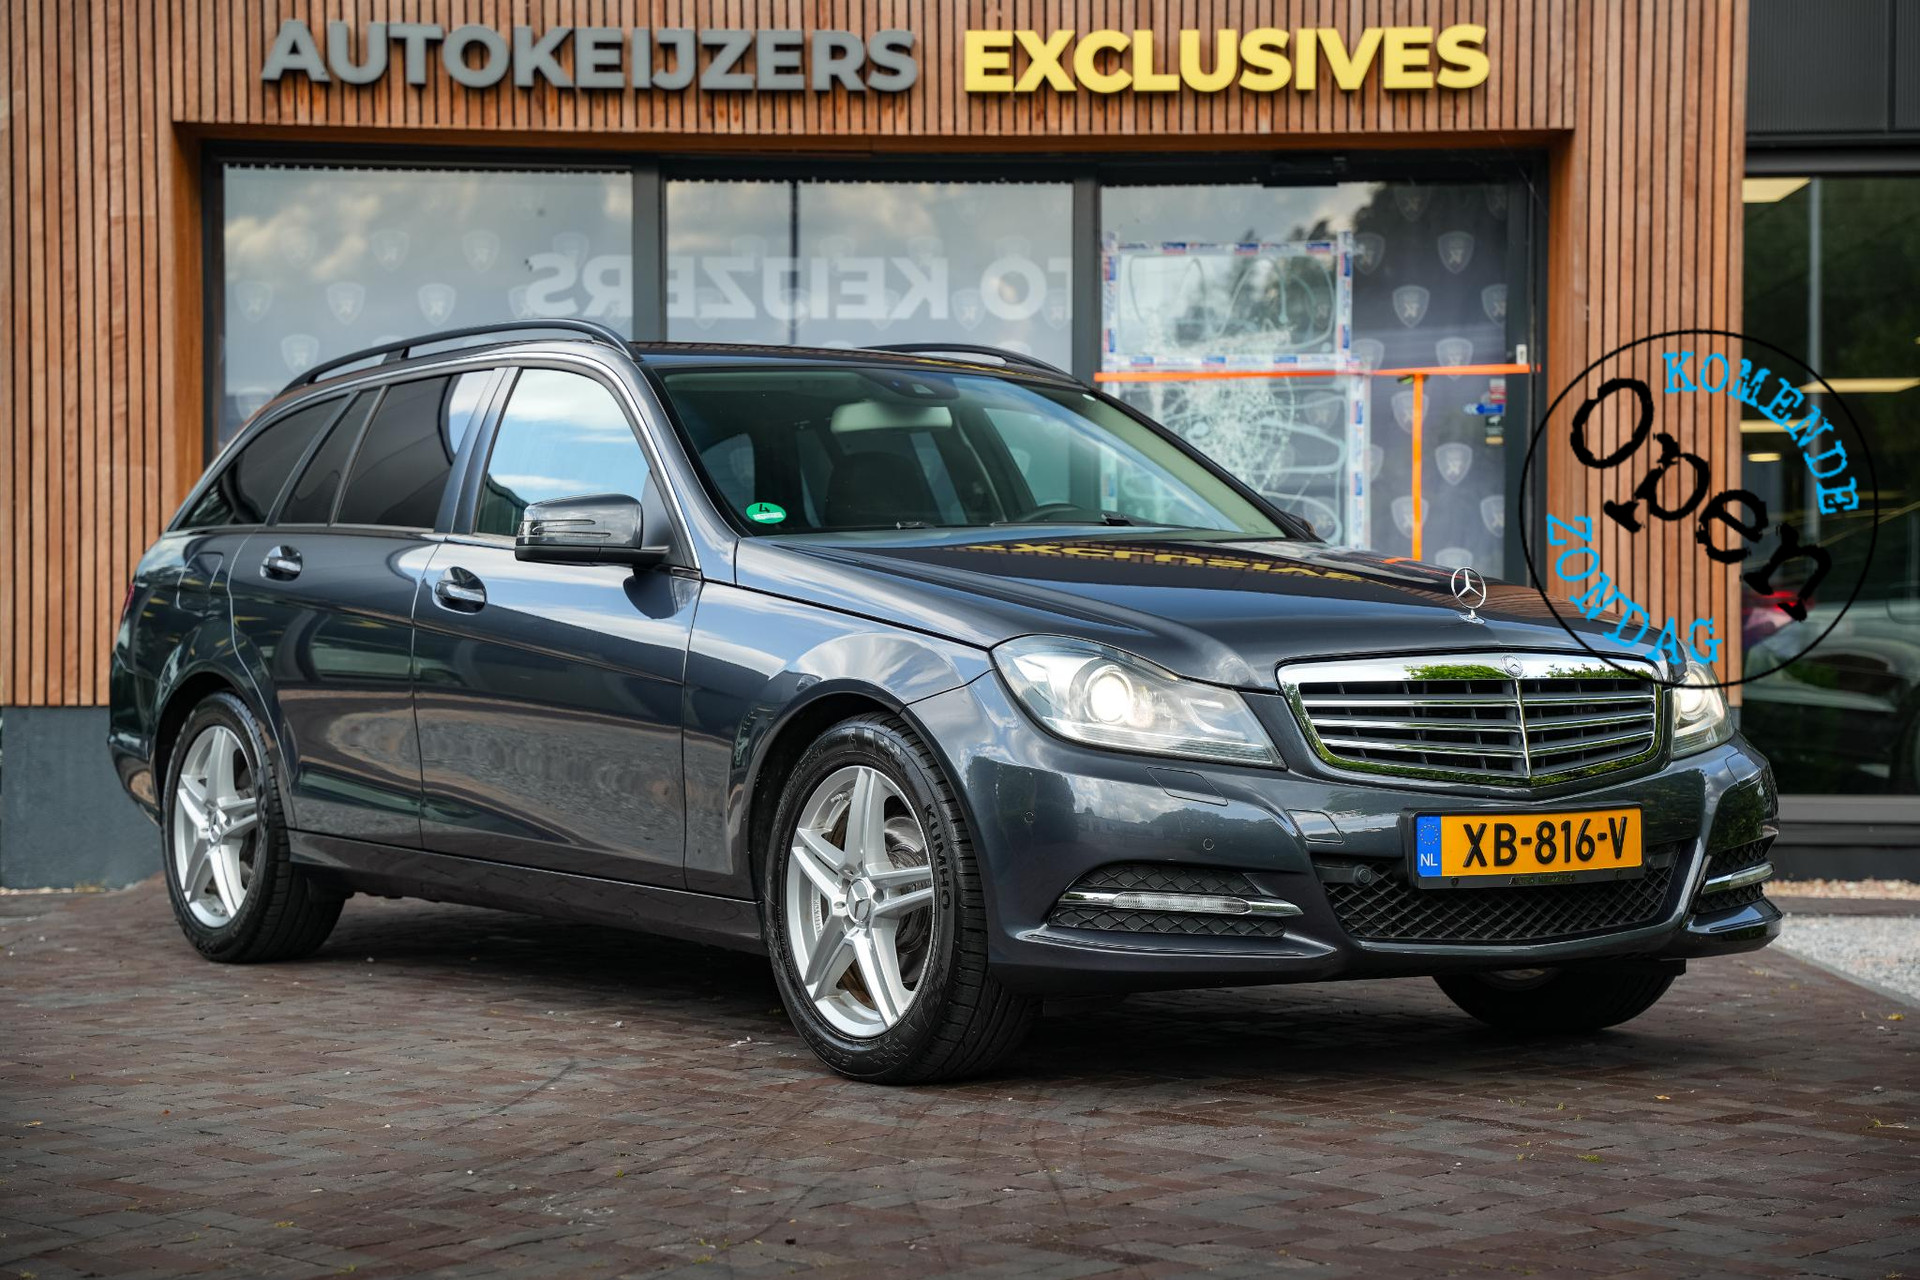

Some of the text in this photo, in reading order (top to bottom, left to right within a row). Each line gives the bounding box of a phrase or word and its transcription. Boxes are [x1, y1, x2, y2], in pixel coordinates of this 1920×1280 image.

[963, 24, 1491, 94] EXCLUSIVES
[924, 803, 951, 910] KUMHO
[1420, 816, 1628, 868] NL XB-816-V
